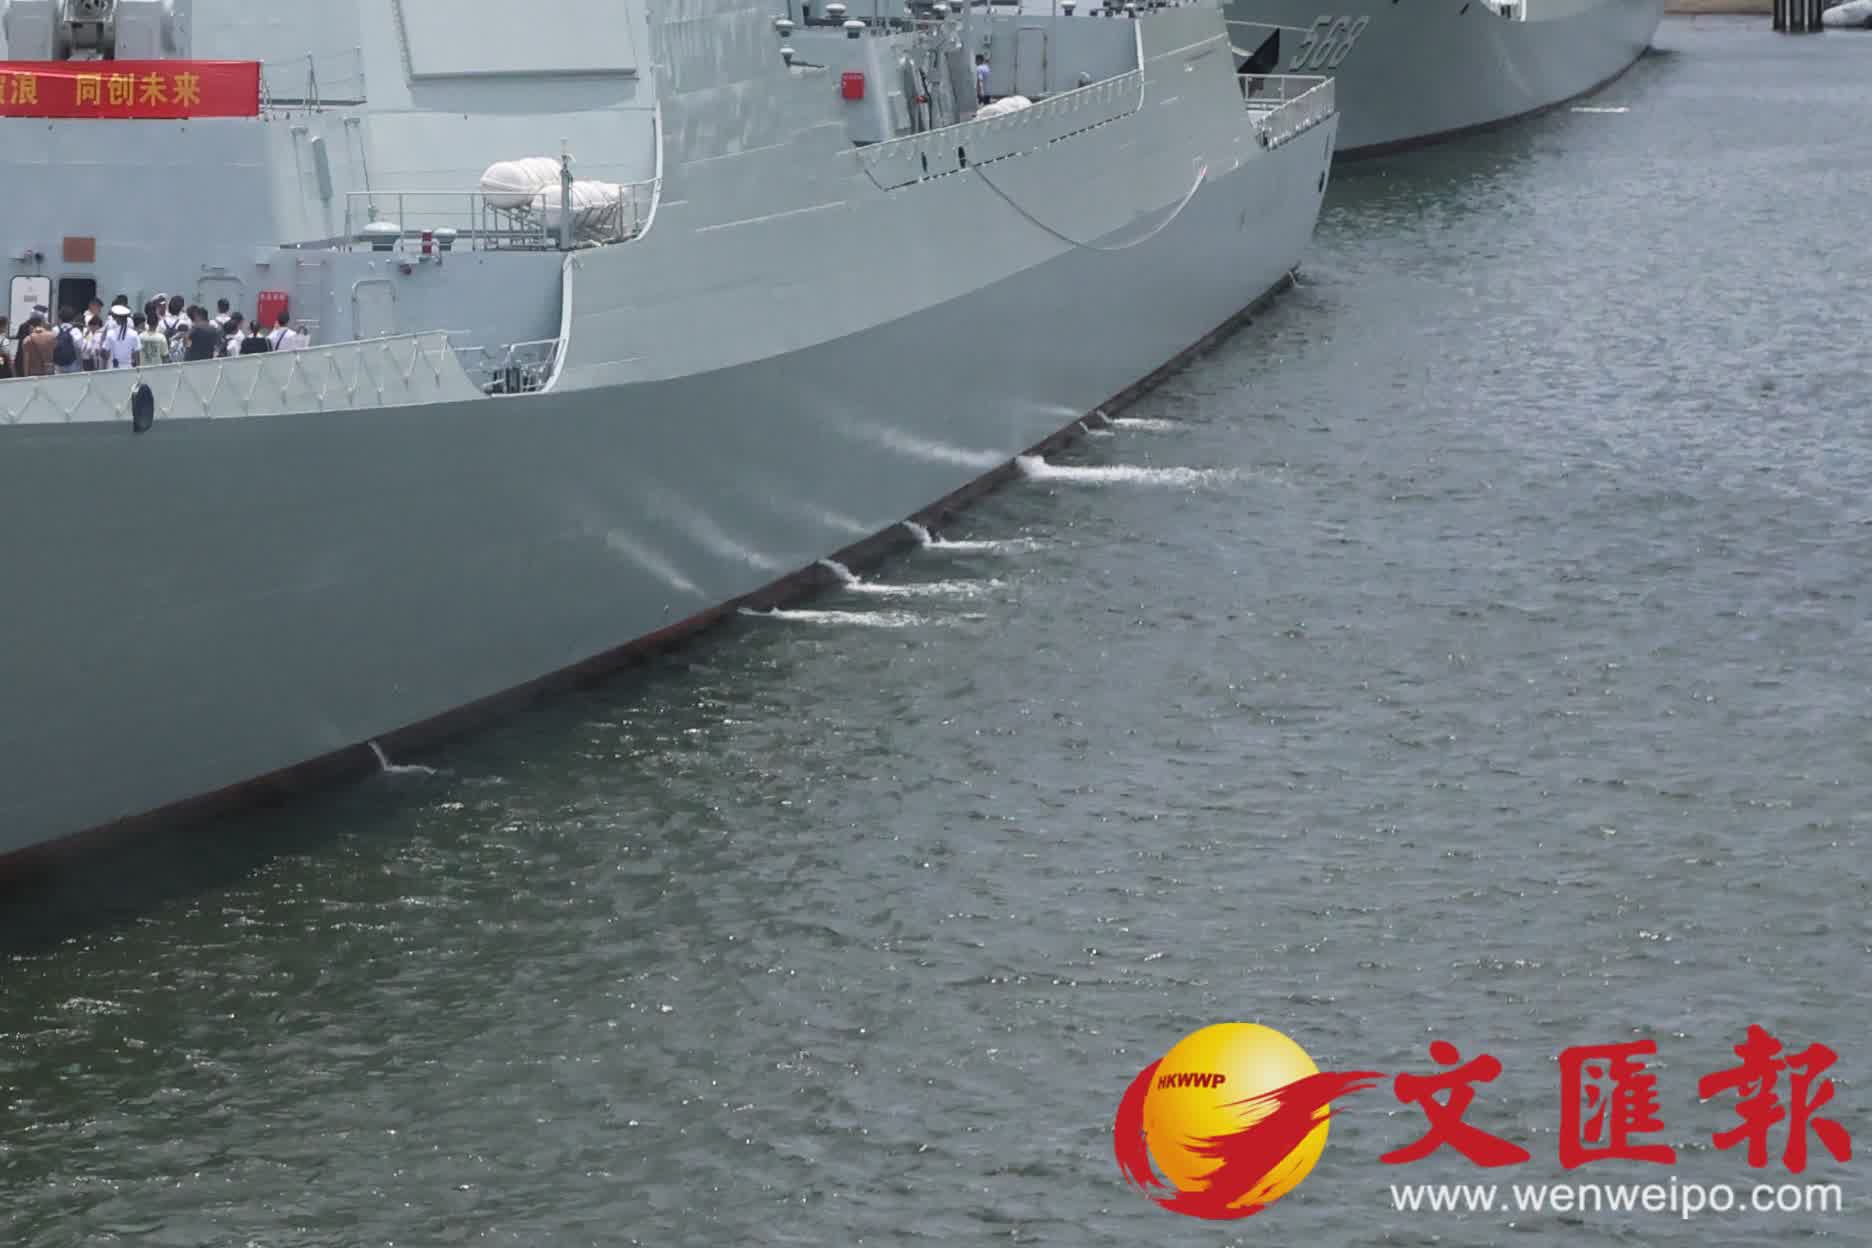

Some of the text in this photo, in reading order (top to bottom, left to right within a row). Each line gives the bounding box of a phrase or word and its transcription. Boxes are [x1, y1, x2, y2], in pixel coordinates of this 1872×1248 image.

[1289, 15, 1371, 73] 568
[76, 71, 201, 107] 同创未来
